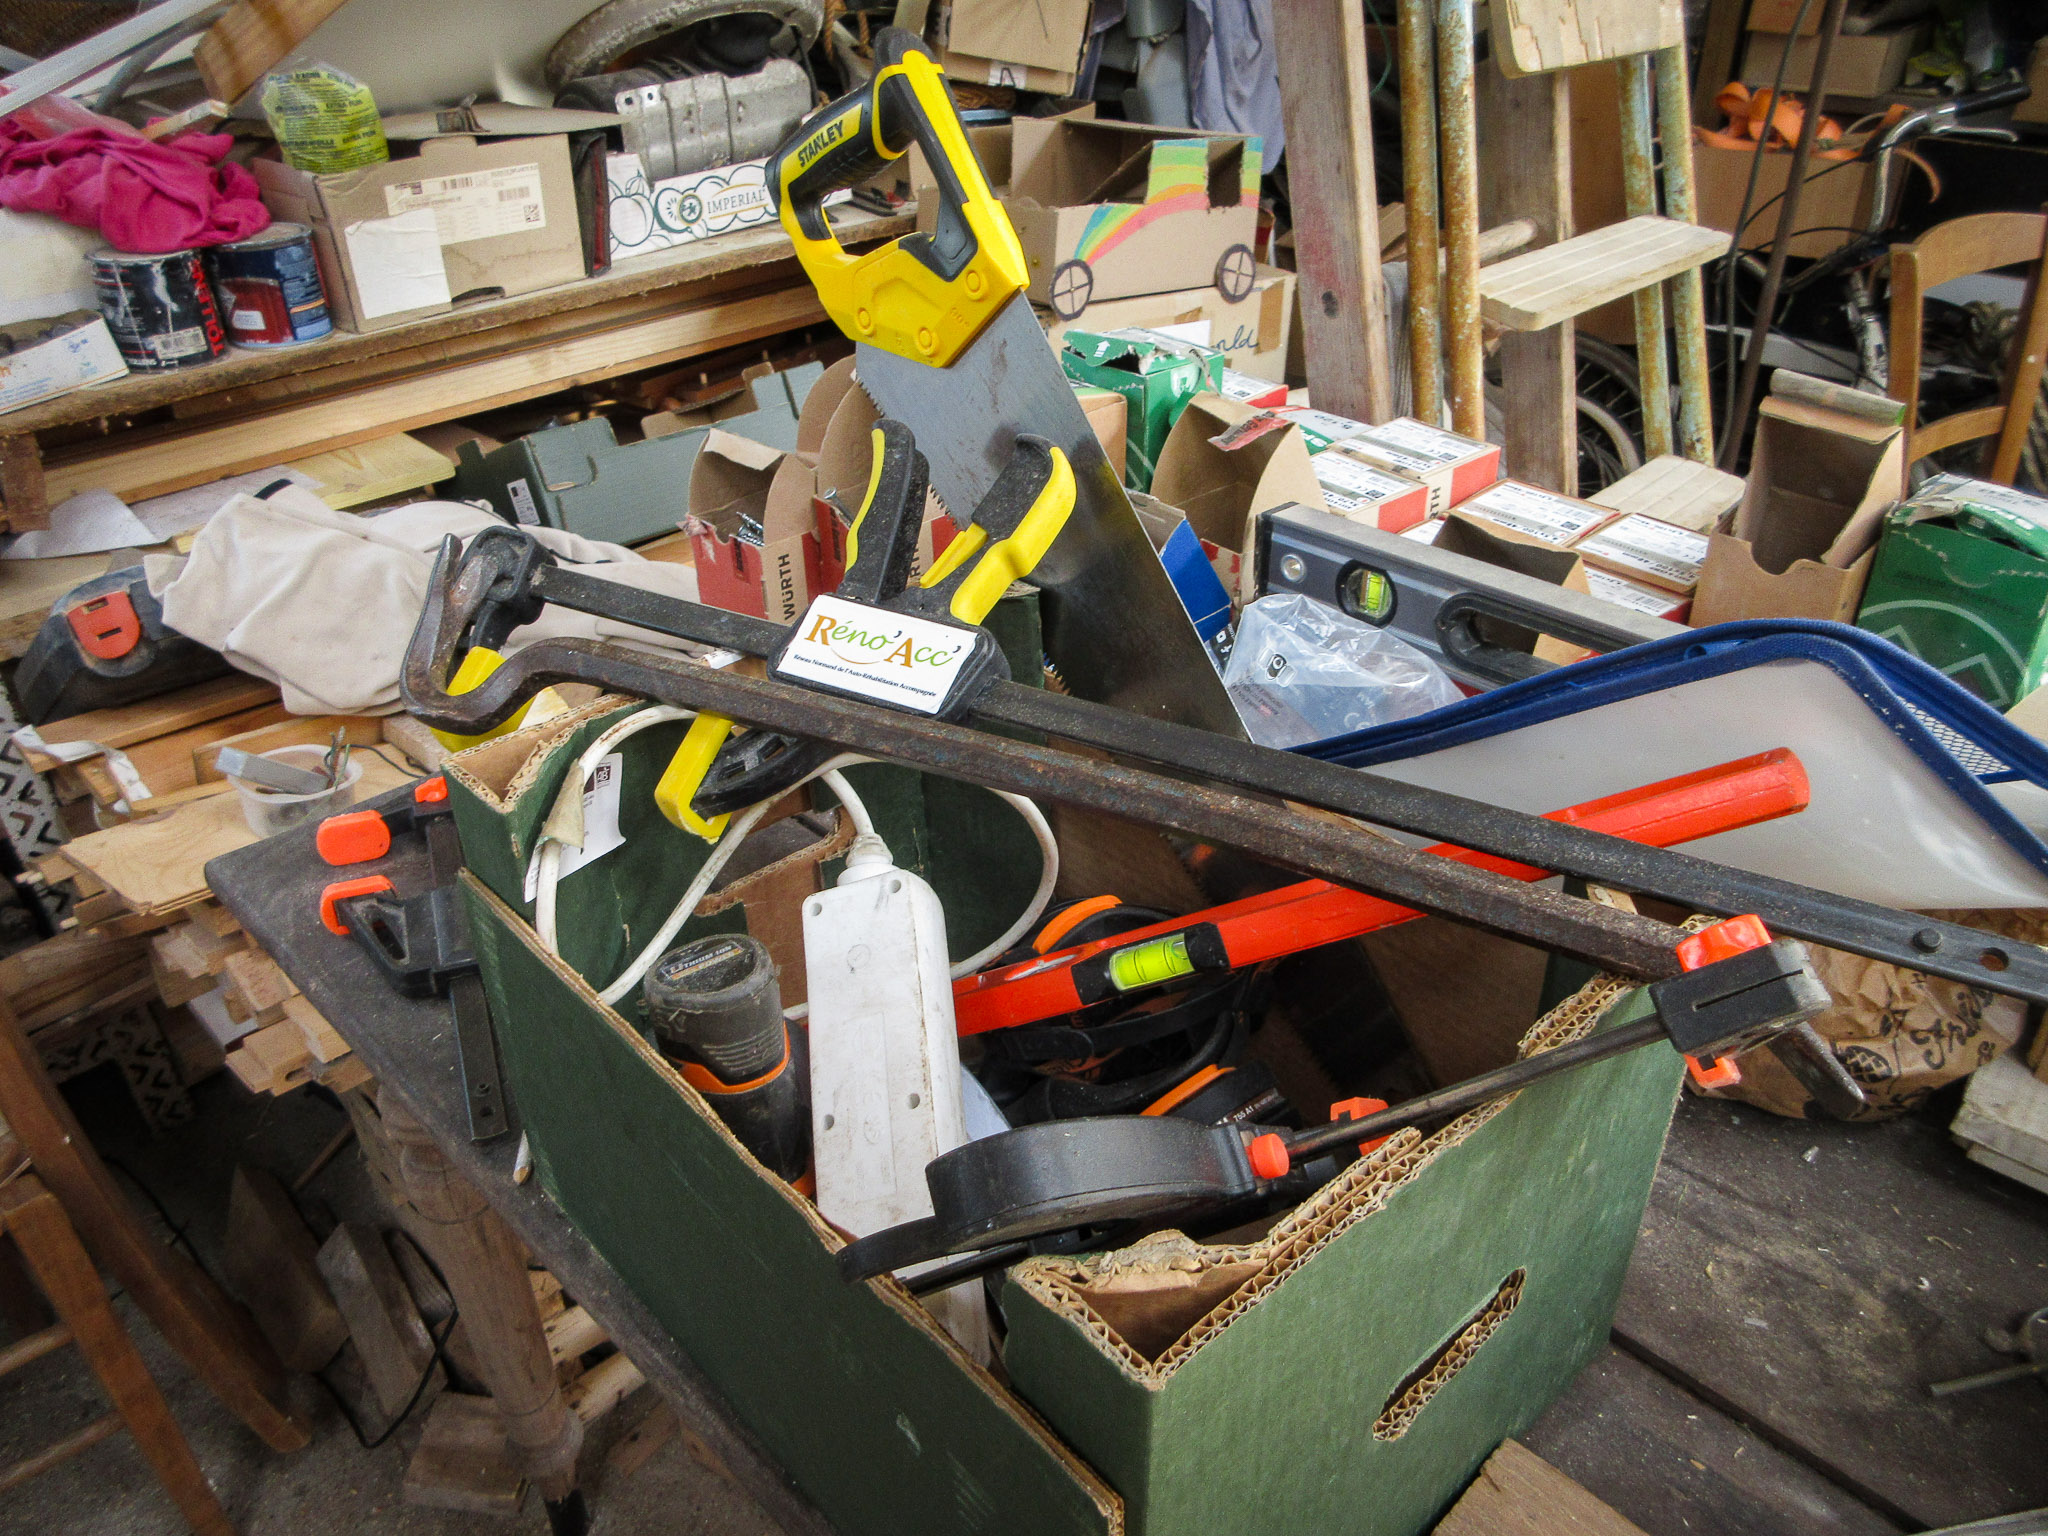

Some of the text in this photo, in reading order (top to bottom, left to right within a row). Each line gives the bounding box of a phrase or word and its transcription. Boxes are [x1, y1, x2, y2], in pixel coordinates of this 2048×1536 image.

[797, 120, 845, 167] STANLEY
[707, 189, 765, 214] IMPERIAL
[778, 554, 795, 620] WÜRTH
[812, 658, 838, 671] Normand
[1233, 1111, 1246, 1122] 755
